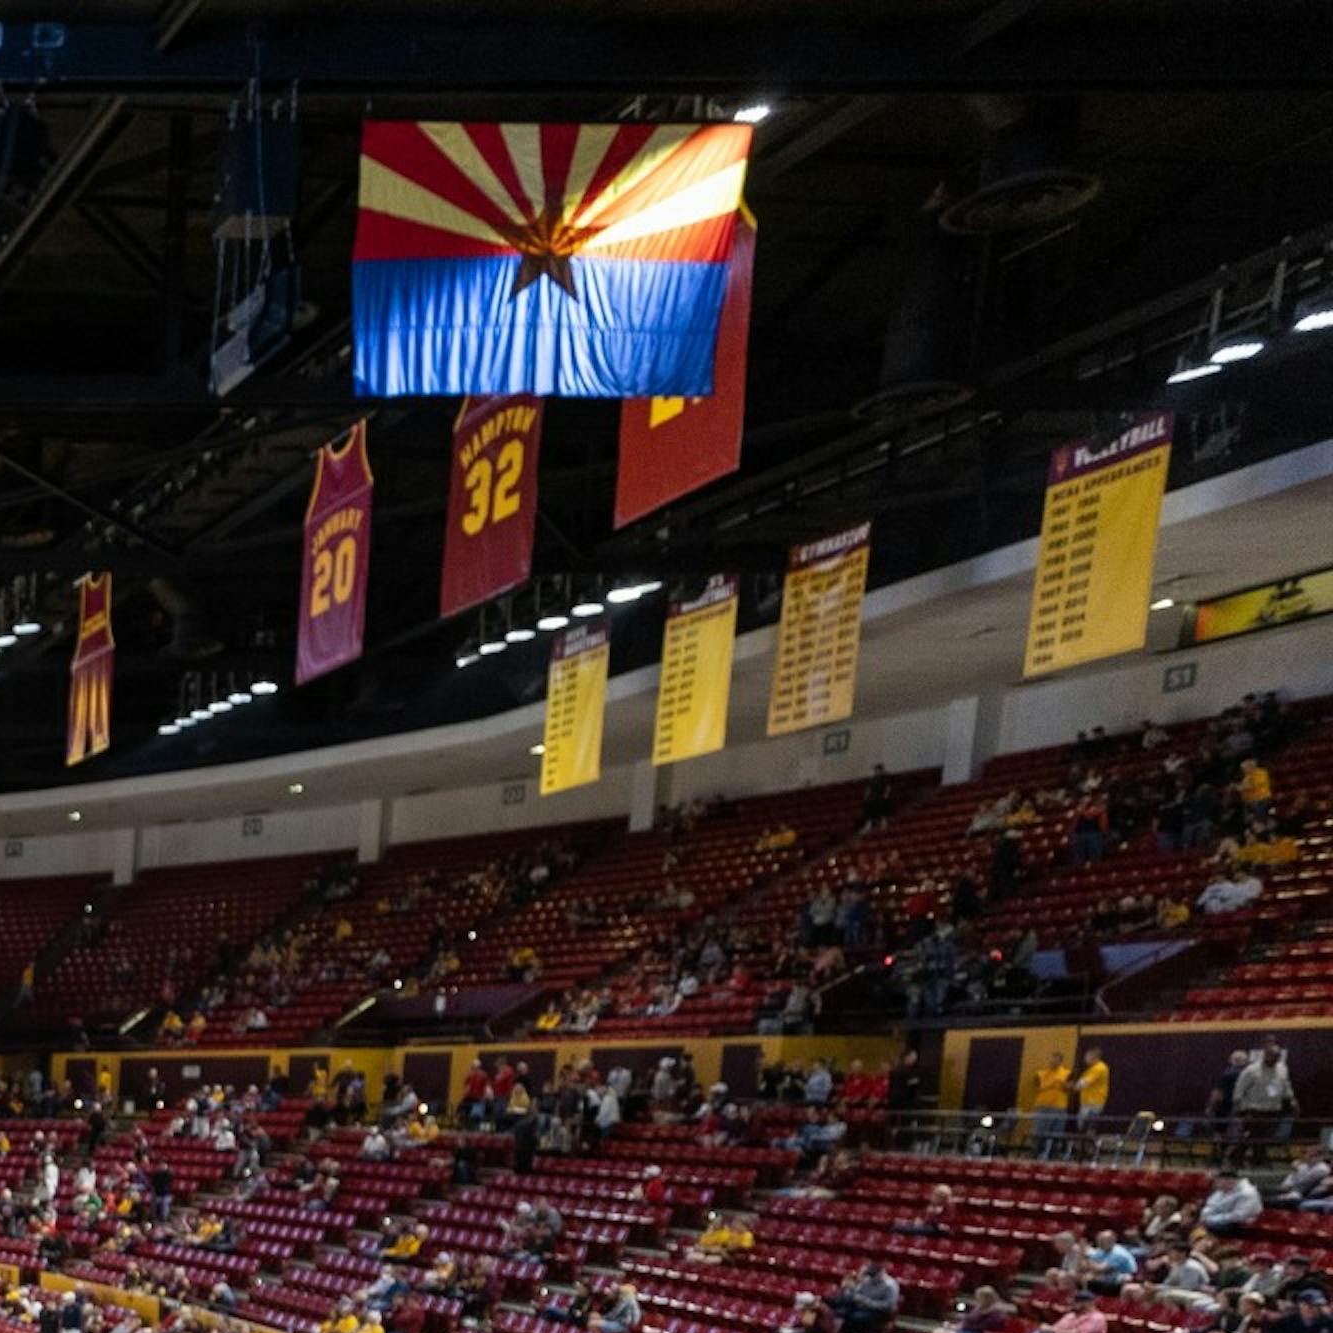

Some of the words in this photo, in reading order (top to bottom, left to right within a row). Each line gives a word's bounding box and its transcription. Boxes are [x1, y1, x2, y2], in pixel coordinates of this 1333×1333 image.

[459, 404, 538, 471] HAMPTON
[461, 439, 524, 536] 32
[311, 506, 365, 557] JANUARY
[309, 536, 356, 619] 20
